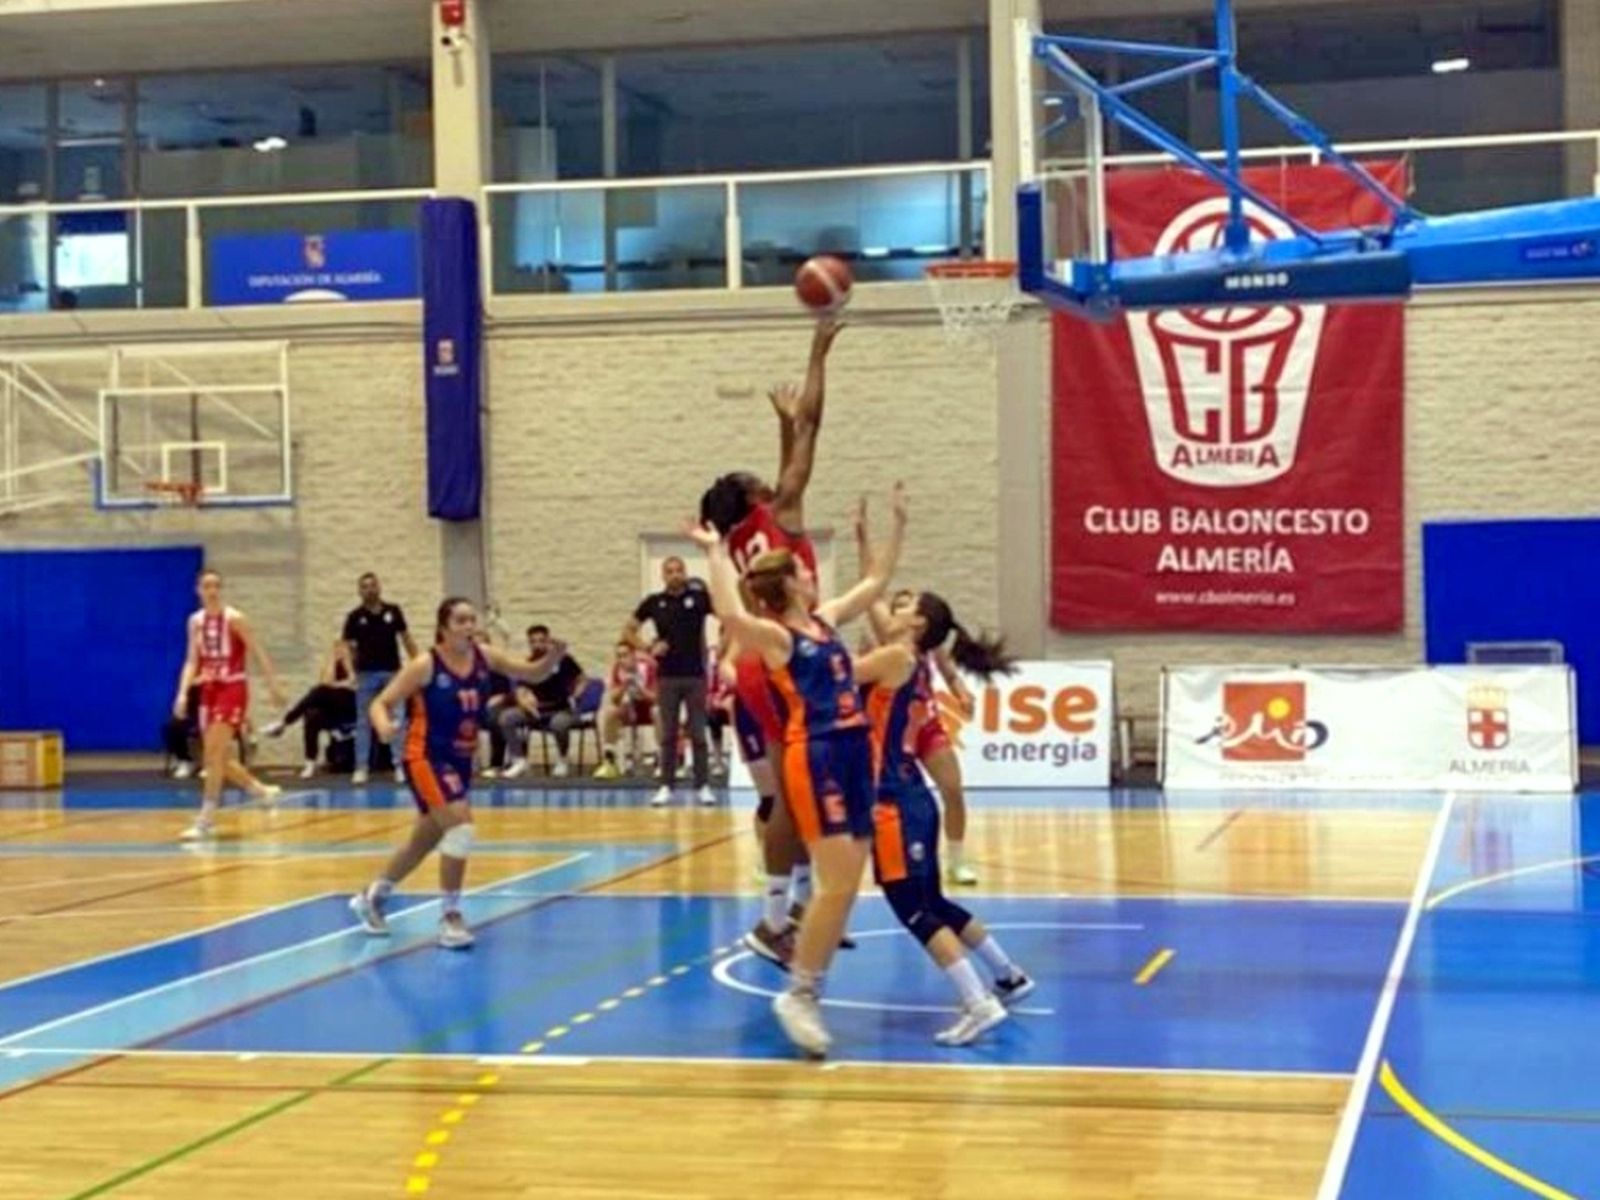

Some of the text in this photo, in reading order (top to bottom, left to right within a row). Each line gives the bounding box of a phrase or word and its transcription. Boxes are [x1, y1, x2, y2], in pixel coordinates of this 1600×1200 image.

[1225, 272, 1288, 289] MONDO
[1084, 506, 1369, 535] CLUB BALONCESTO
[1156, 542, 1294, 573] ALMERÍA
[982, 738, 1097, 767] energía
